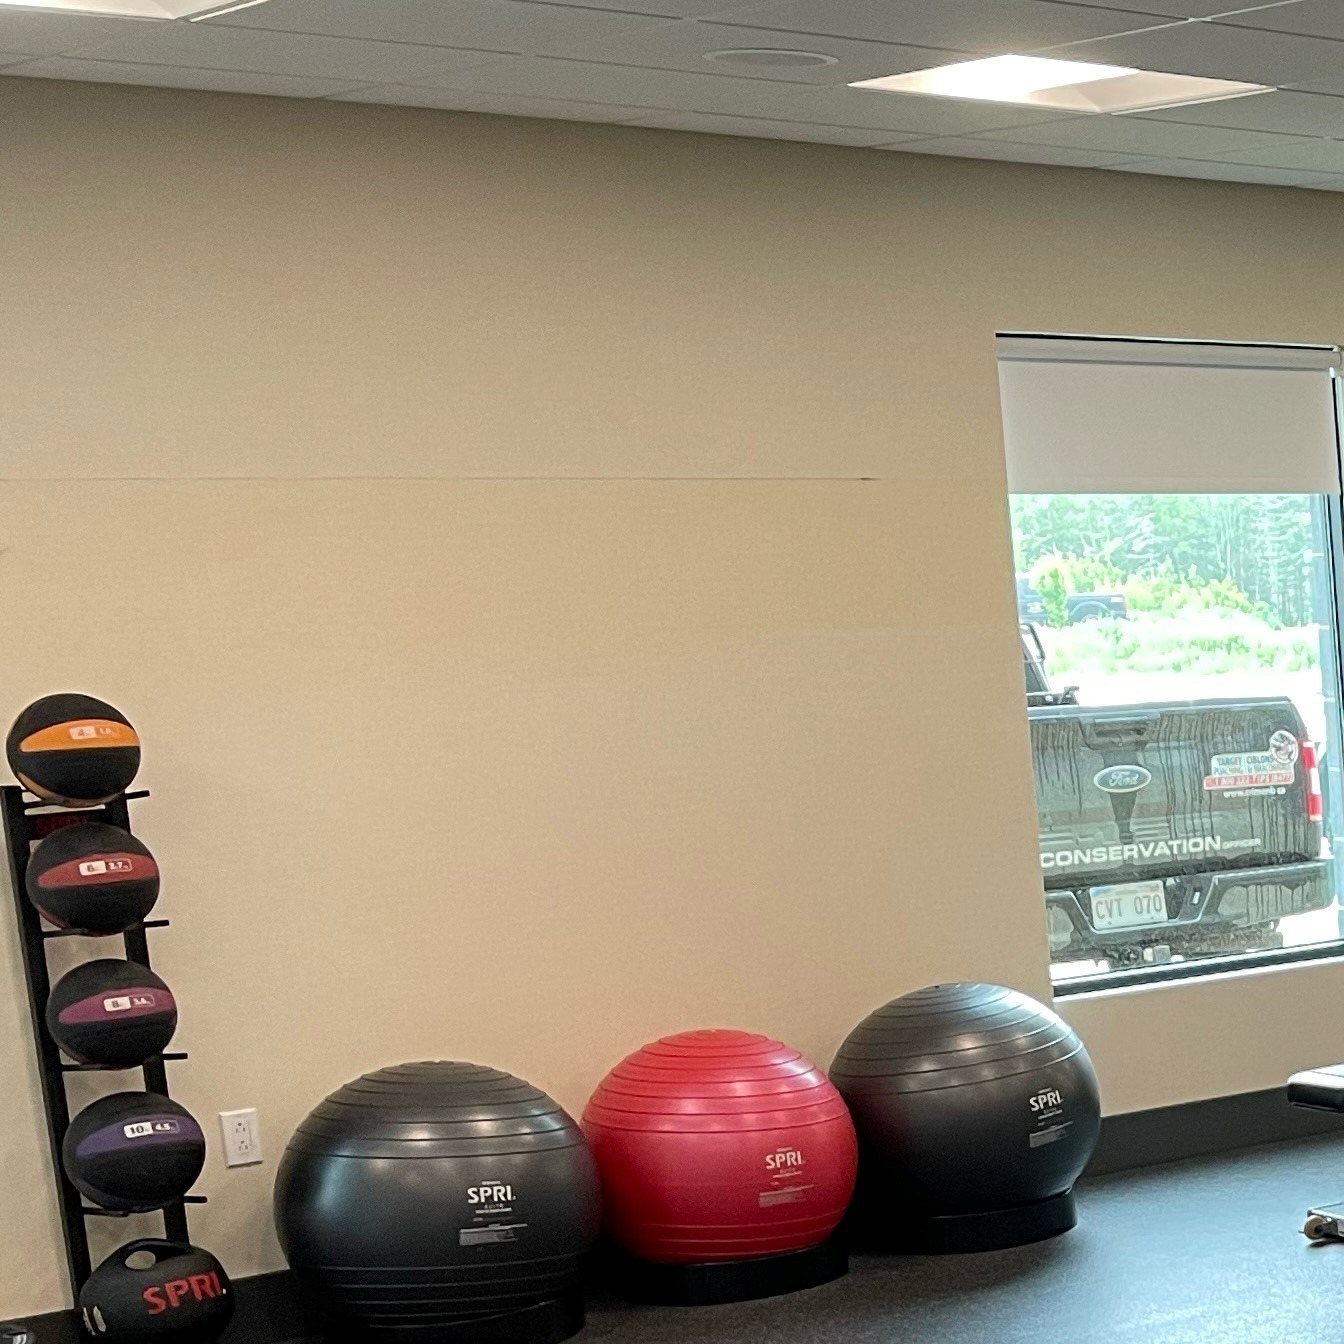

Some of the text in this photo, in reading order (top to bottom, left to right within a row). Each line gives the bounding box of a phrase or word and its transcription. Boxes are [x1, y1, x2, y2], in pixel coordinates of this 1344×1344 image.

[1108, 771, 1139, 788] Ford
[1040, 835, 1221, 869] CONSERVATION
[1095, 894, 1163, 920] CVT 070
[1029, 1089, 1061, 1112] SPRI
[129, 1125, 145, 1134] 10
[765, 1150, 802, 1170] SPRI
[466, 1185, 512, 1204] SPRI
[142, 1271, 222, 1315] SPRI
